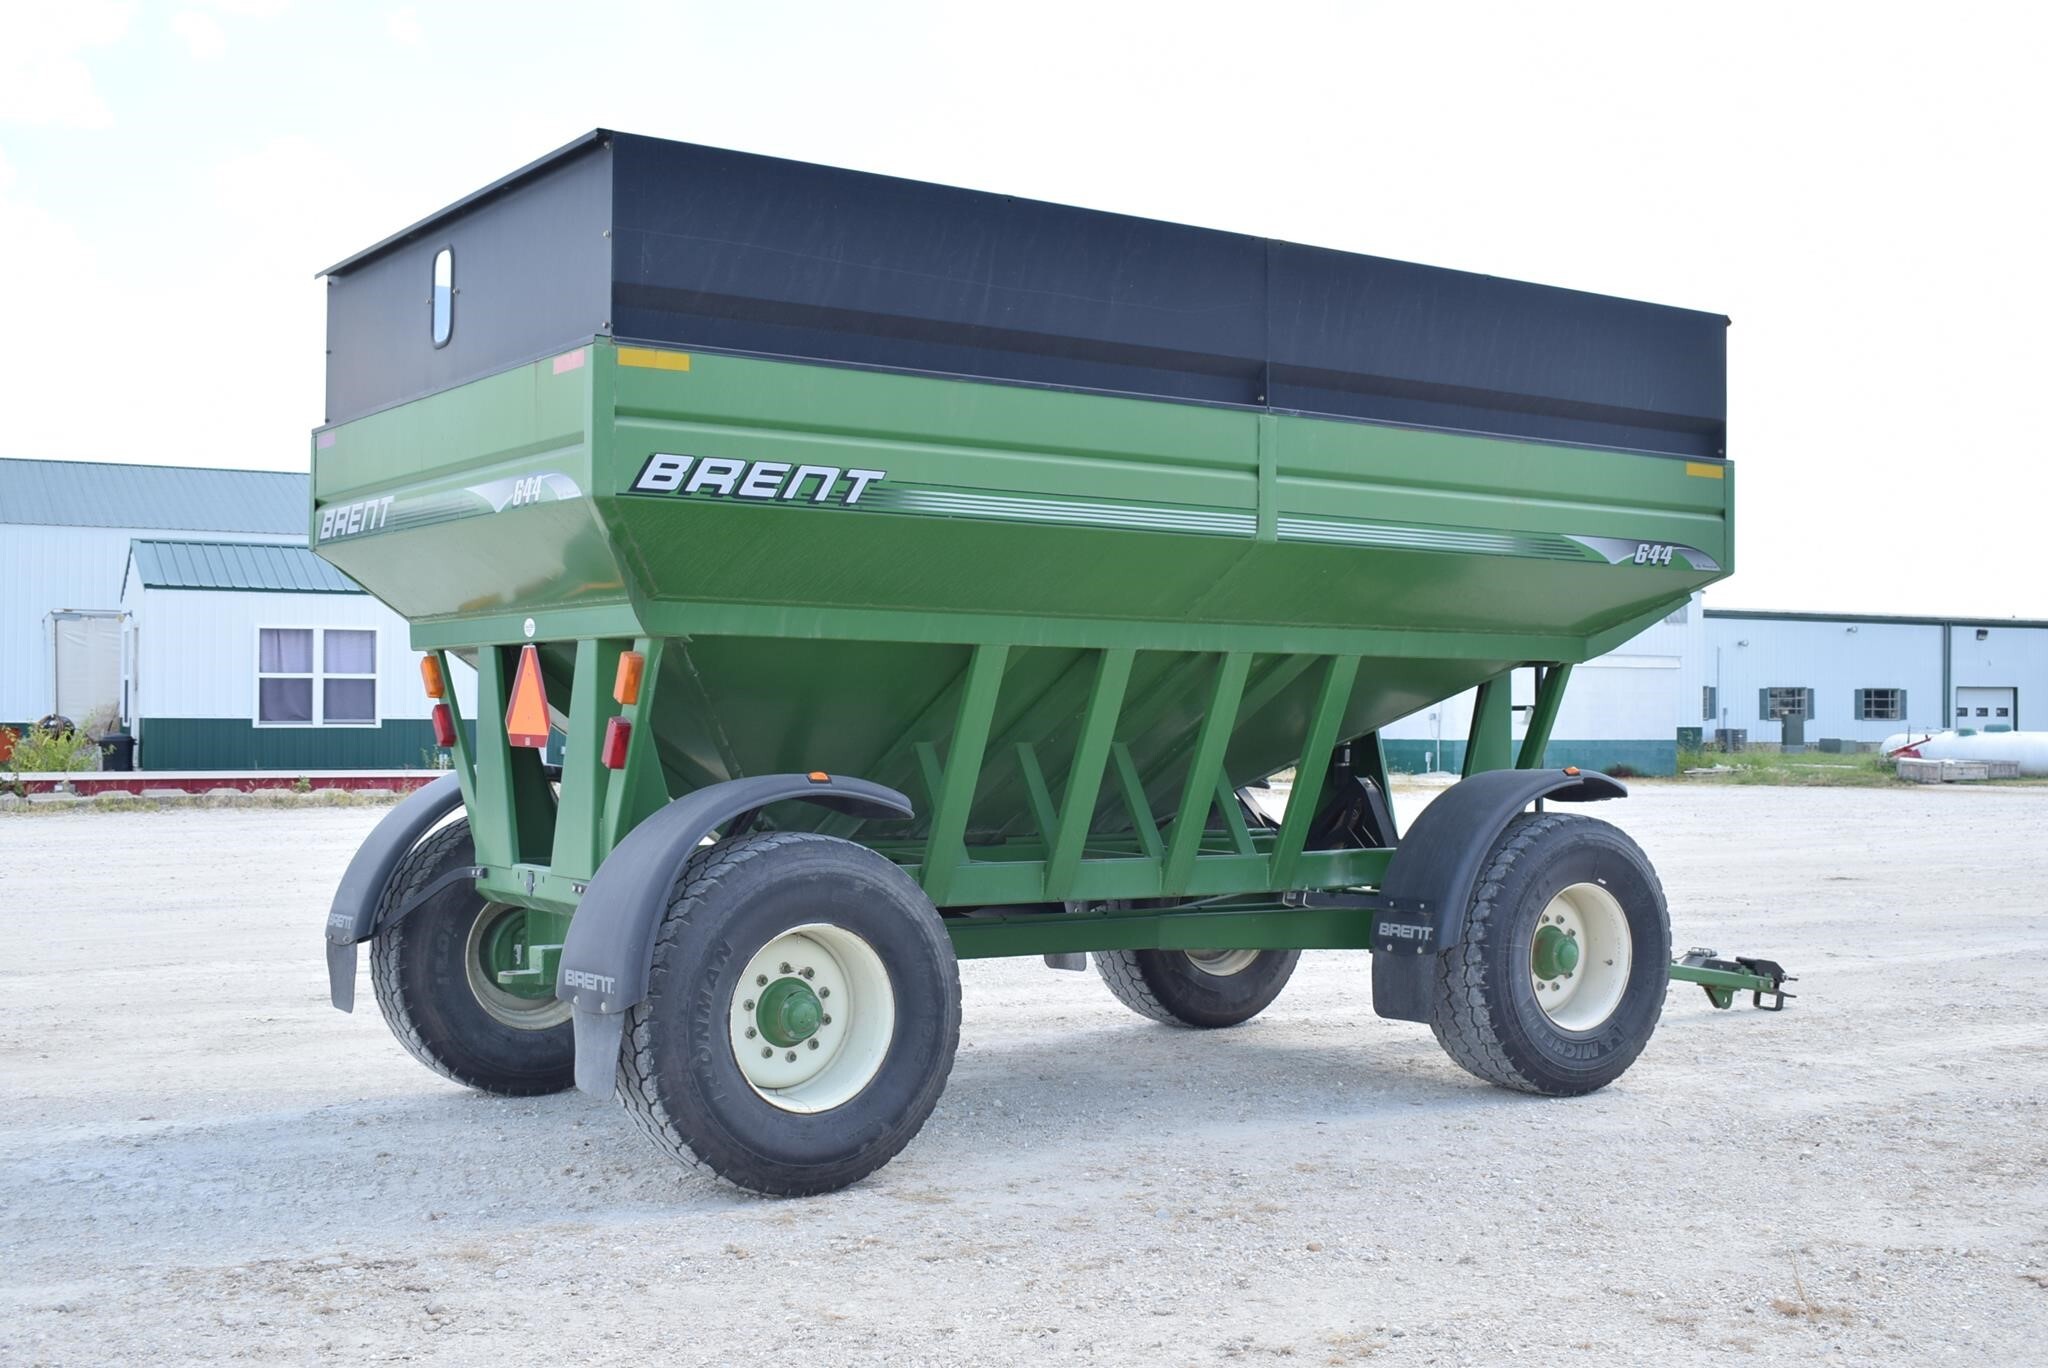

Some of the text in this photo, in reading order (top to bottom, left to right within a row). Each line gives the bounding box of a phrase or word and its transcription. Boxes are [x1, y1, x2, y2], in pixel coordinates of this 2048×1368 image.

[512, 475, 542, 507] 644
[631, 452, 887, 505] BRENT
[319, 496, 395, 541] BRENT
[1632, 543, 1673, 566] 644
[1379, 922, 1433, 940] BRENT
[565, 969, 615, 994] BRENT
[696, 937, 733, 1101] IRONMAN
